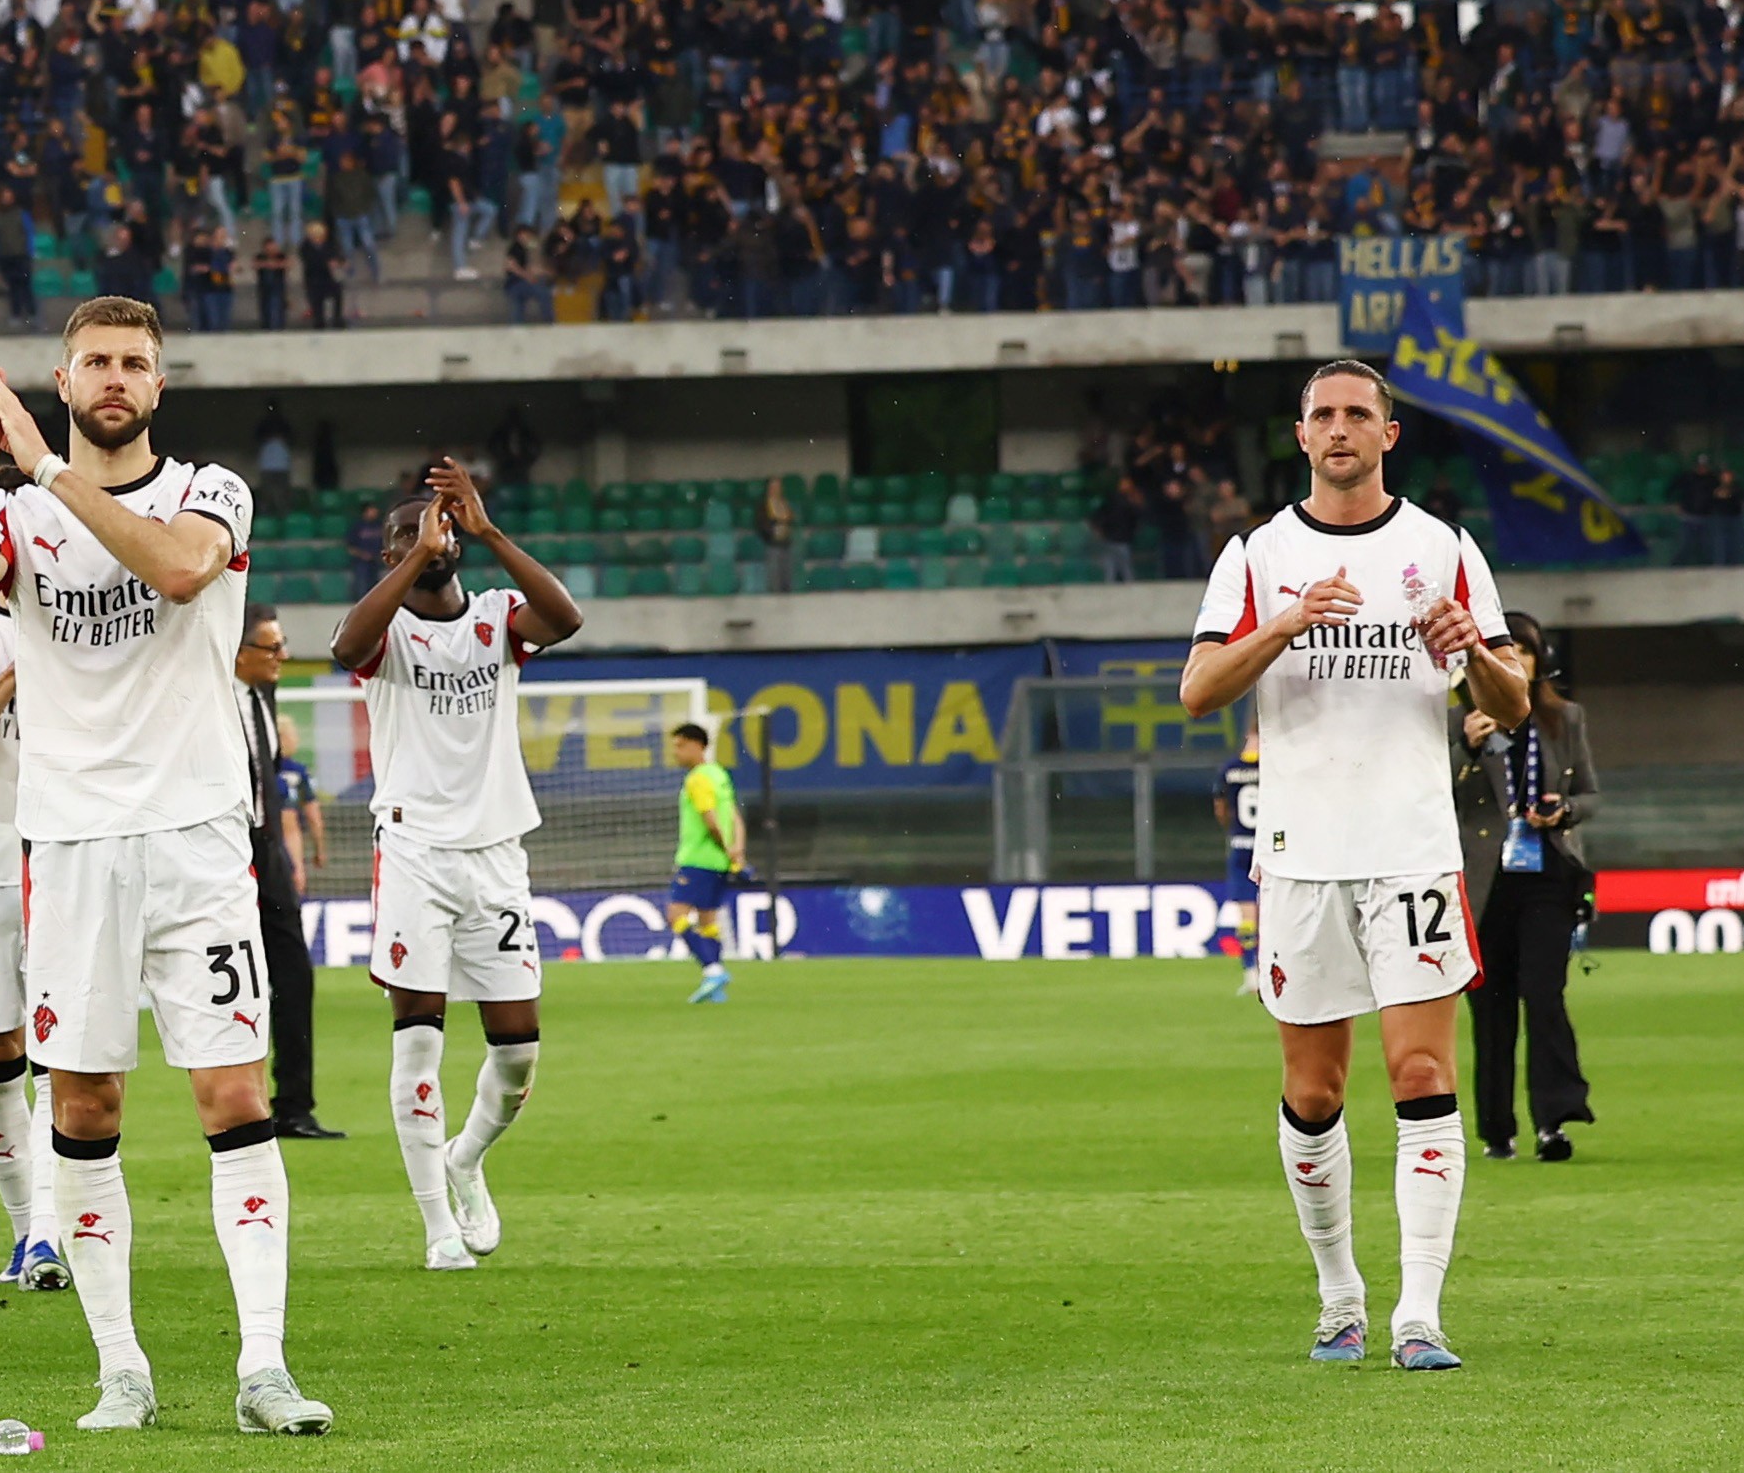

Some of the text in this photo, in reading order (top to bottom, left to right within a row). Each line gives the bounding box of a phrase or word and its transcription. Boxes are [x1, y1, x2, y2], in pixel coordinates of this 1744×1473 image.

[1339, 234, 1464, 279] HELLAS
[194, 490, 246, 521] MSC
[34, 573, 159, 617] Emirate
[52, 608, 156, 647] FLY BETTER
[413, 662, 500, 695] Emirate
[1309, 654, 1411, 681] FLY BETTER
[429, 694, 453, 716] FLY
[1398, 888, 1453, 947] 12
[207, 939, 261, 1006] 31
